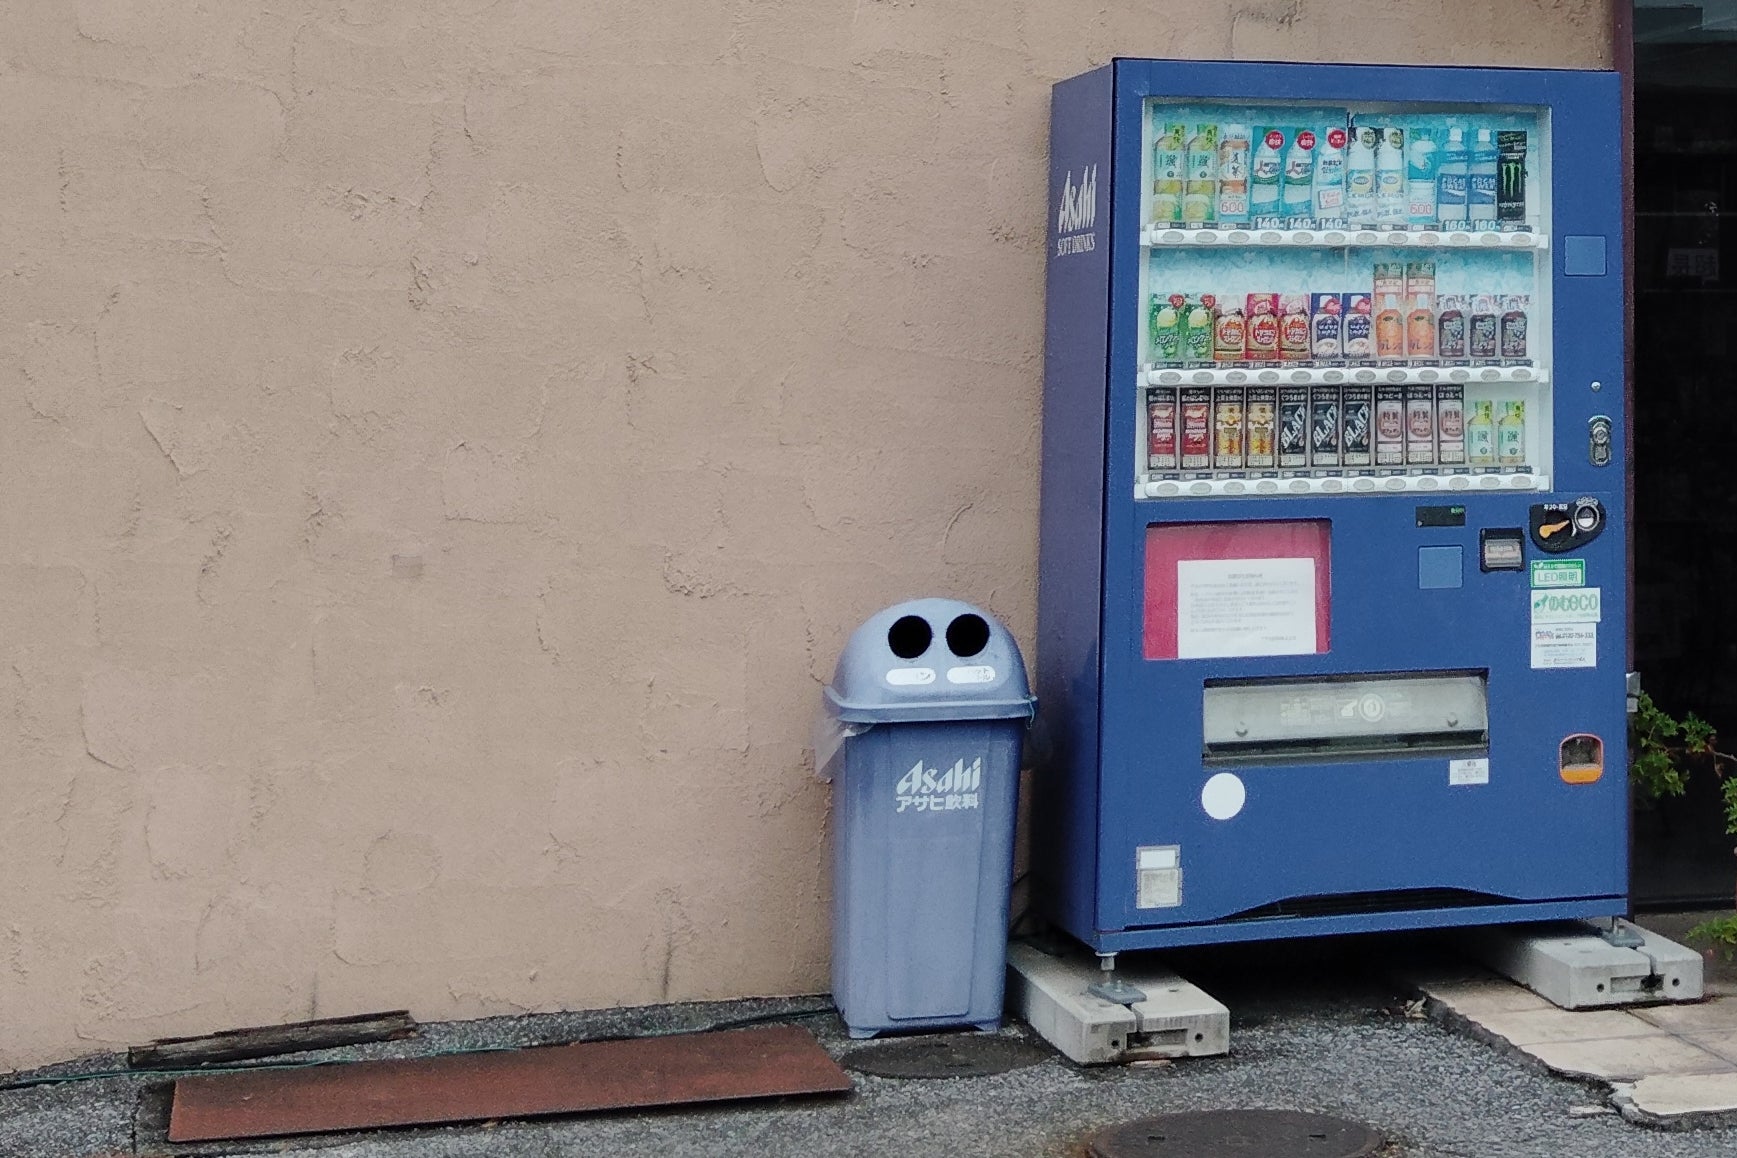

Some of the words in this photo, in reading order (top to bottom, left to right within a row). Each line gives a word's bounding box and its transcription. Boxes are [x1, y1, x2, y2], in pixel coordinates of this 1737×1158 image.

[1058, 163, 1097, 233] Asahi
[1072, 232, 1096, 253] DRINKS
[896, 756, 981, 795] Asahi
[896, 792, 979, 813] アサヒ飲料
